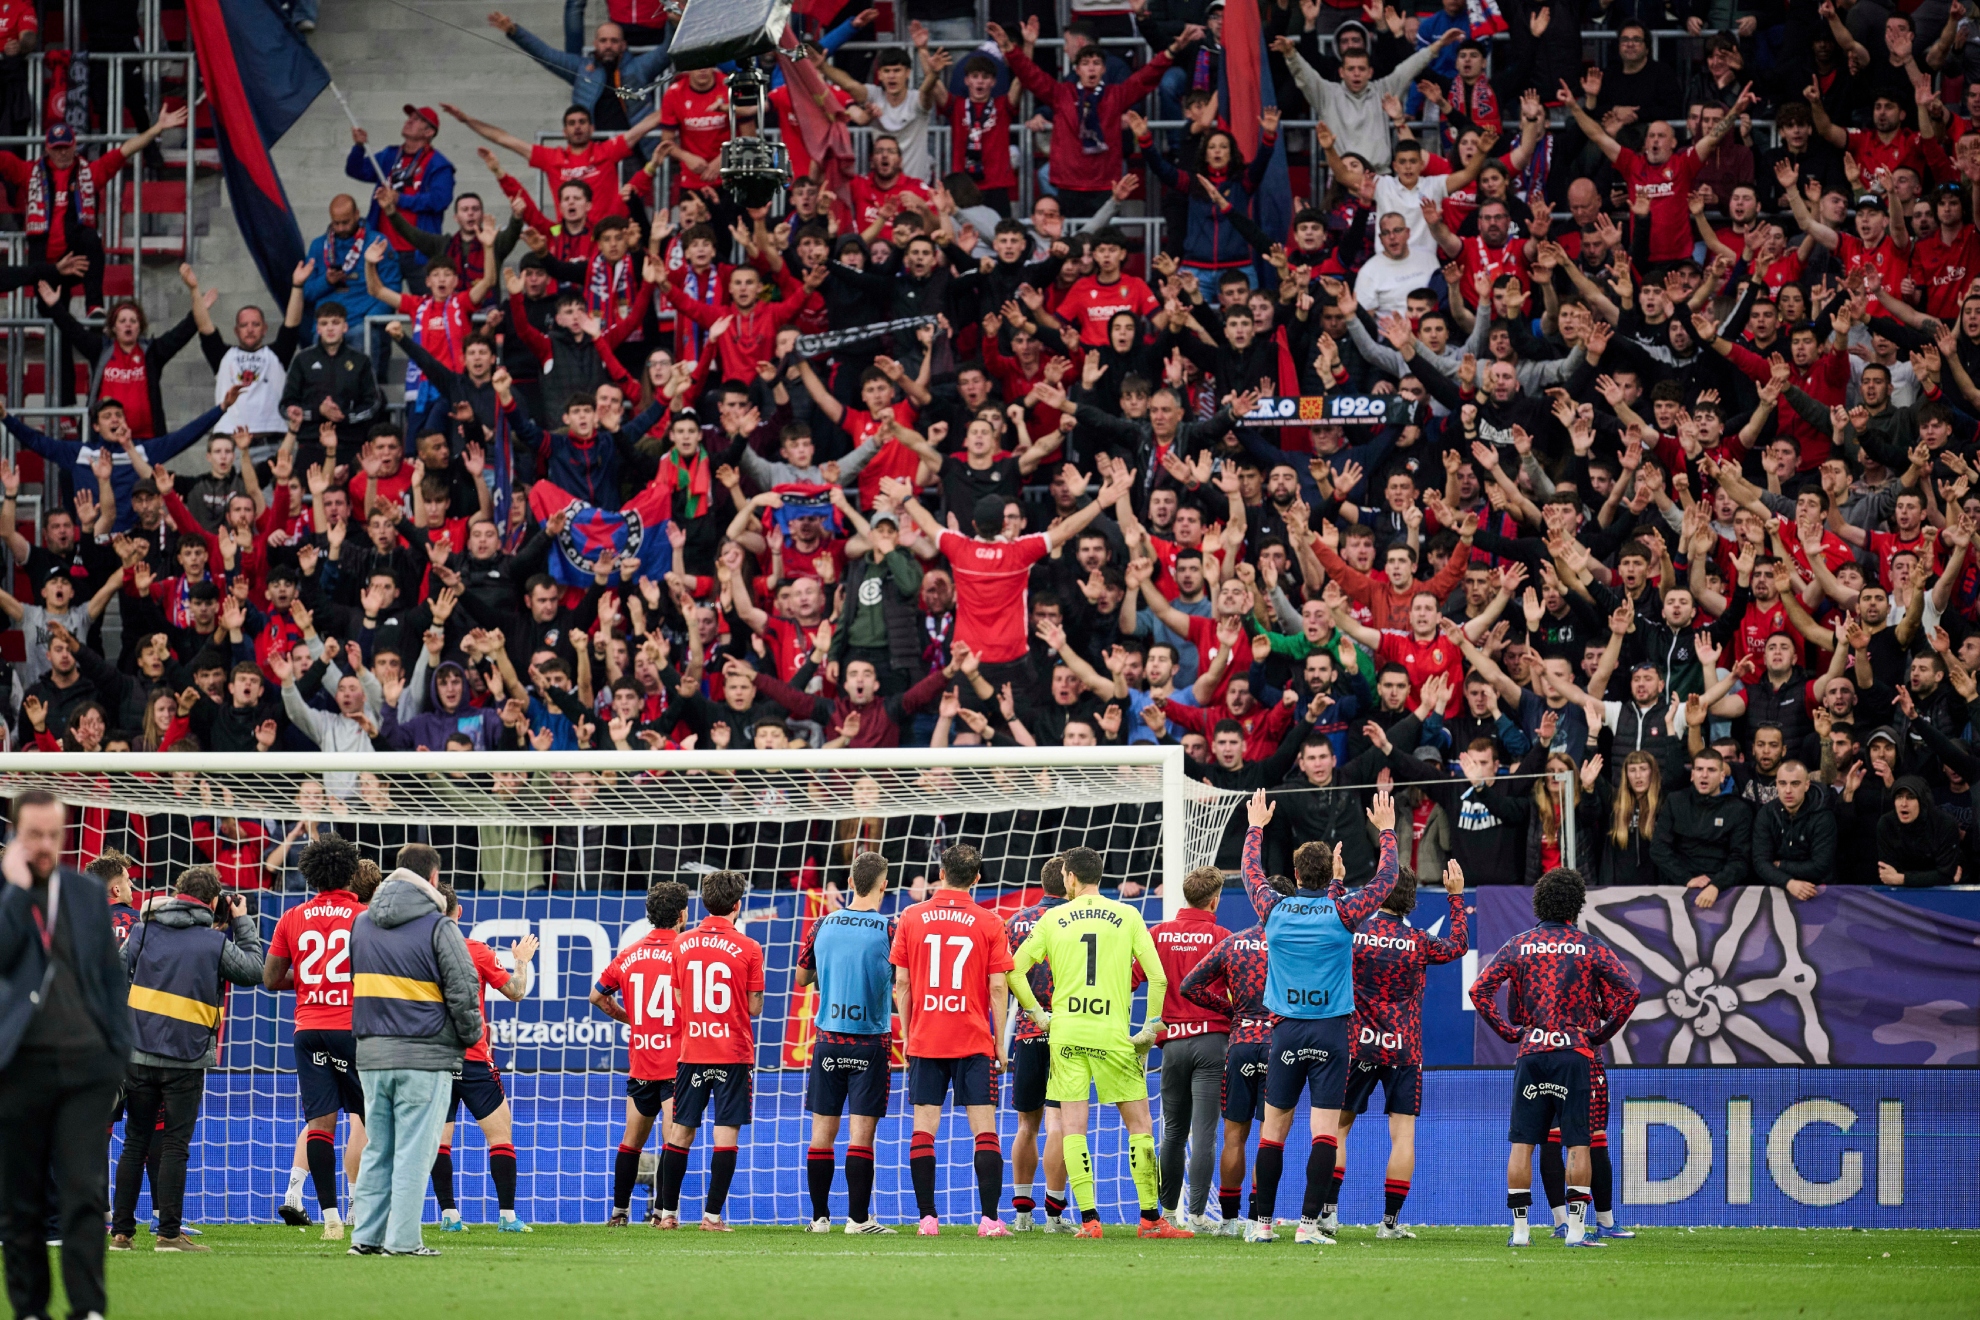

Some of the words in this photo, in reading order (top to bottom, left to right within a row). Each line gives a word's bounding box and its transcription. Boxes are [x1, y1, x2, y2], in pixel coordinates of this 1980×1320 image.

[1332, 396, 1386, 416] 1920
[303, 904, 353, 920] BOYOMO
[1278, 901, 1333, 915] macron
[824, 914, 885, 931] macron
[921, 909, 976, 928] BUDIMIR
[1069, 908, 1124, 929] HERRERA
[679, 936, 700, 955] MOI
[701, 935, 743, 958] GÓMEZ
[1157, 931, 1214, 945] macron
[1353, 932, 1416, 952] macron
[297, 928, 351, 985] 22
[1520, 942, 1586, 956] macron
[619, 946, 651, 974] RUBÉN
[923, 933, 974, 990] 17
[1079, 933, 1097, 987] 1
[686, 960, 732, 1014] 16
[628, 973, 676, 1027] 14
[923, 994, 967, 1012] DIGI
[1068, 996, 1111, 1016] DIGI
[1286, 988, 1330, 1006] DIGI
[831, 1003, 867, 1022] DIGI
[688, 1021, 731, 1038] DIGI
[1166, 1020, 1208, 1039] DIGI
[1359, 1027, 1403, 1050] DIGI
[1529, 1027, 1572, 1047] DIGI
[633, 1033, 672, 1050] DIGI
[836, 1057, 870, 1067] CRYPTO
[1297, 1048, 1329, 1058] CRYPTO
[1538, 1082, 1569, 1095] CRYPTO
[1621, 1097, 1905, 1207] DIGI
